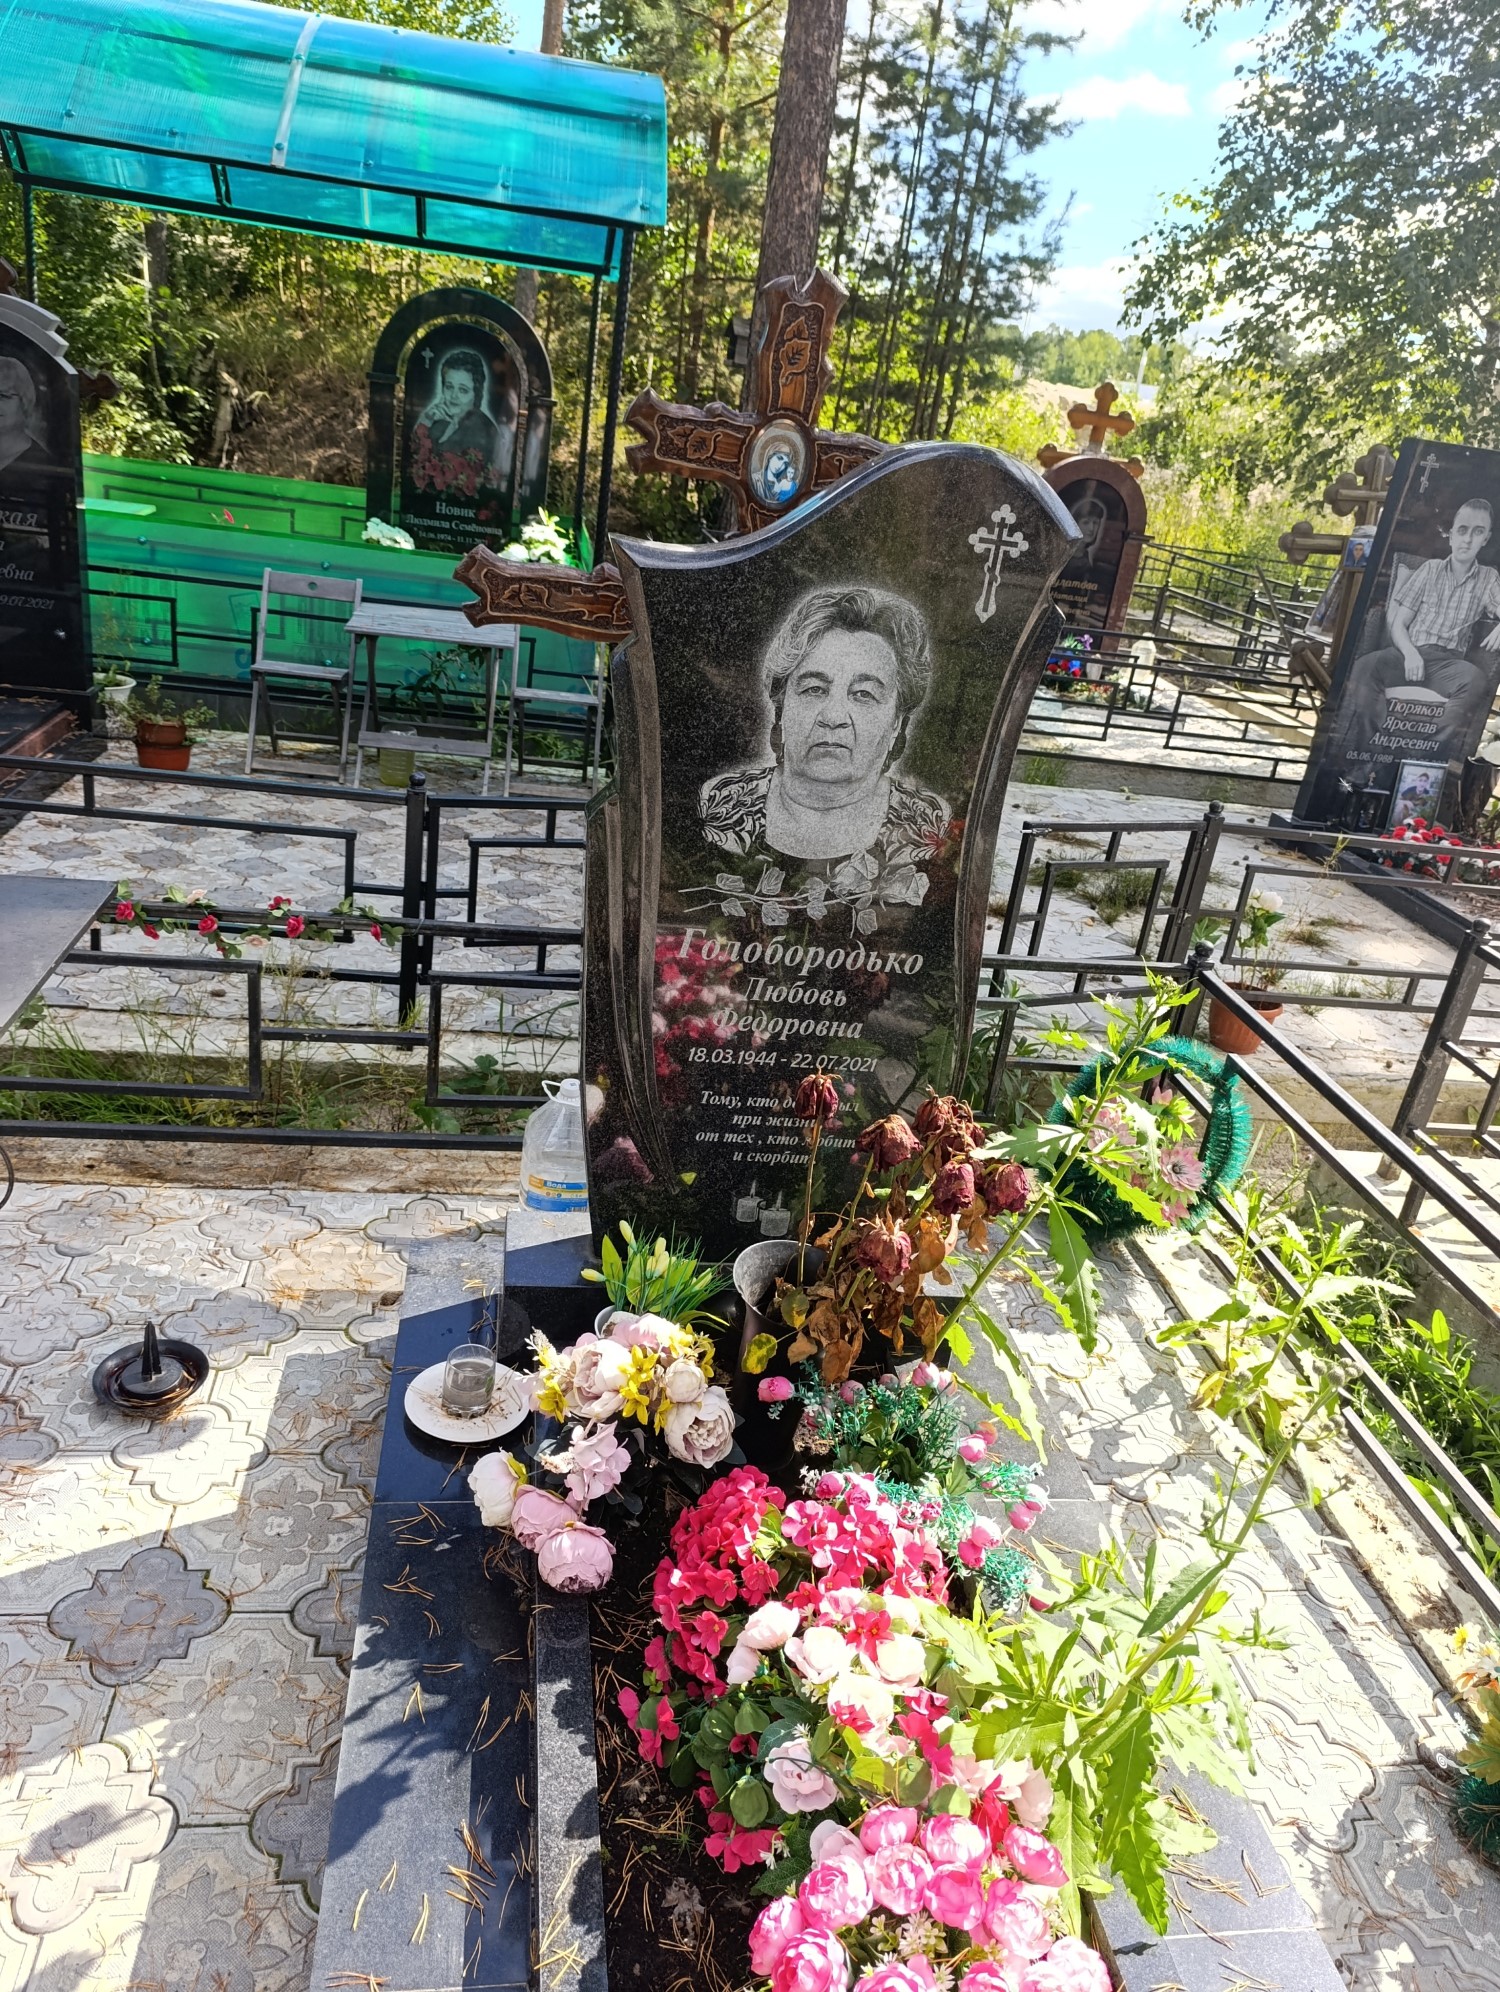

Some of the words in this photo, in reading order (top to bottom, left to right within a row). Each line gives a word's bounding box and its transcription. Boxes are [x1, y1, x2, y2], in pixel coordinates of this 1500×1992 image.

[436, 501, 477, 518] Новик
[405, 514, 450, 529] Людмила
[452, 520, 503, 536] Семёновна
[1388, 699, 1444, 717] Тюряков
[1383, 716, 1437, 734] Ярослав
[1369, 732, 1440, 752] Андреевич
[1346, 750, 1394, 763] 05.06.1988
[676, 927, 924, 976] Голобородько
[745, 977, 847, 1007] Любовь
[713, 1007, 863, 1041] Федоровна
[688, 1047, 777, 1067] 18.03.1944
[790, 1053, 877, 1073] 22.07.2021
[700, 1090, 741, 1108] Тому,
[747, 1096, 778, 1108] кто
[838, 1102, 859, 1112] ыл
[732, 1115, 762, 1129] при
[695, 1131, 719, 1142] от
[767, 1135, 799, 1147] кто
[732, 1151, 743, 1162] и
[546, 1181, 567, 1189] Вода
